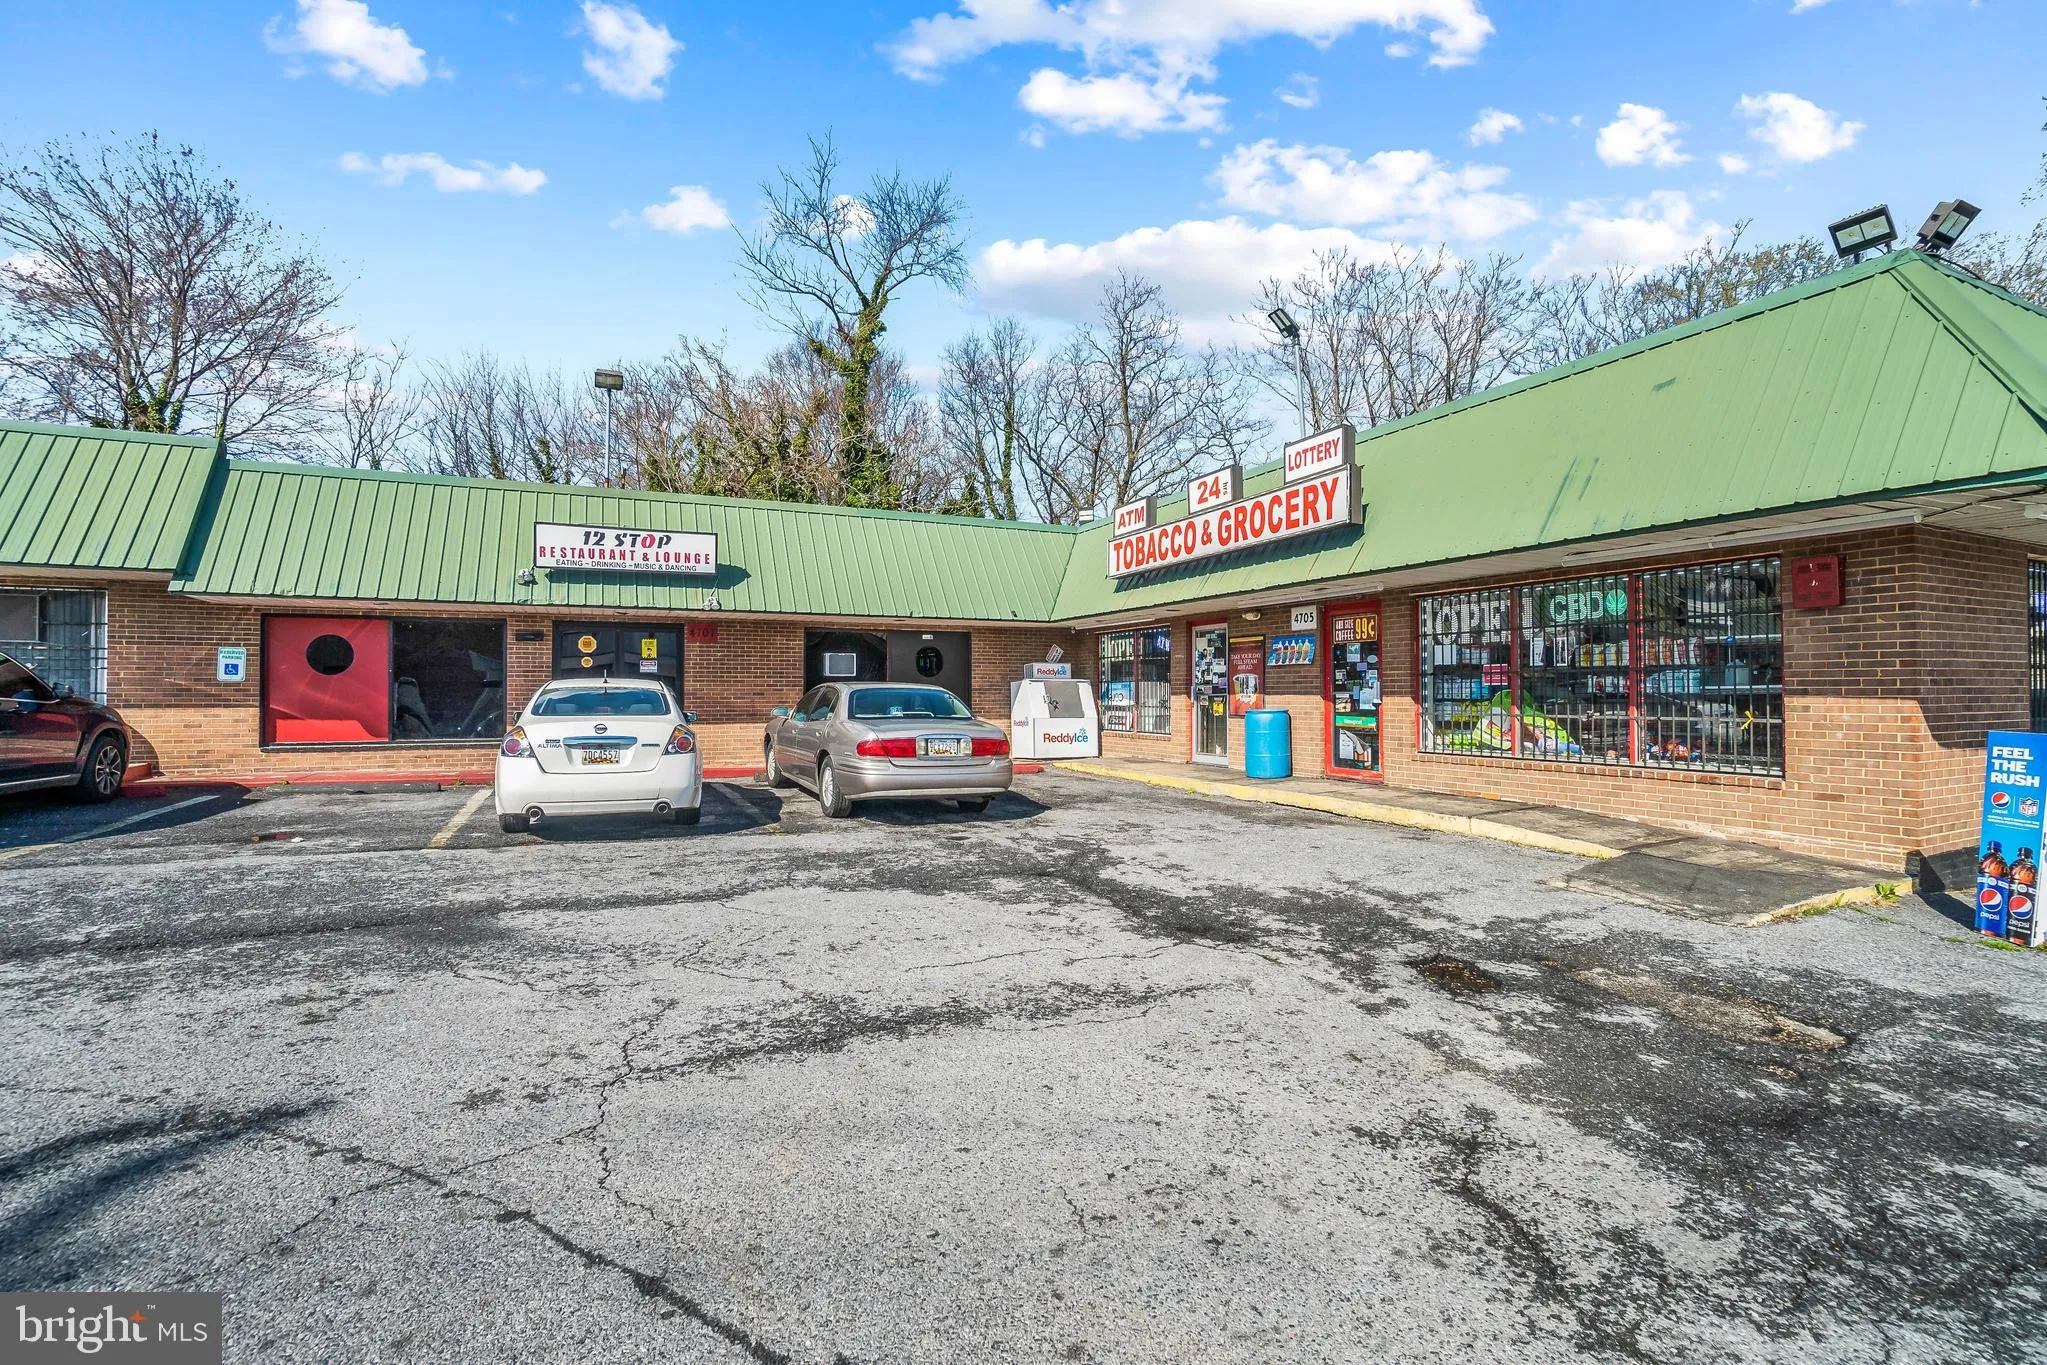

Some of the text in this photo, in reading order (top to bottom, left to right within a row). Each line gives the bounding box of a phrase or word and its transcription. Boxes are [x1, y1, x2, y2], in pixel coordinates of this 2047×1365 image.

[1288, 437, 1340, 472] LOTTERY
[1197, 476, 1221, 504] 24
[1113, 477, 1340, 572] TOBACCO & GROCERY
[1118, 505, 1145, 530] ATM
[584, 531, 672, 549] 12 STOP
[539, 546, 710, 565] RESTAURANT & LOUNGE
[556, 559, 583, 567] EATING
[1550, 591, 1604, 622] CBD
[1294, 612, 1315, 624] 4705
[1336, 630, 1354, 641] COFFEE
[1991, 746, 2034, 761] FEEL
[1992, 759, 2027, 773] THE
[1990, 772, 2040, 788] RUSH
[2021, 804, 2037, 815] NFL
[1980, 911, 2000, 921] pepsi
[2009, 918, 2030, 928] pepsi
